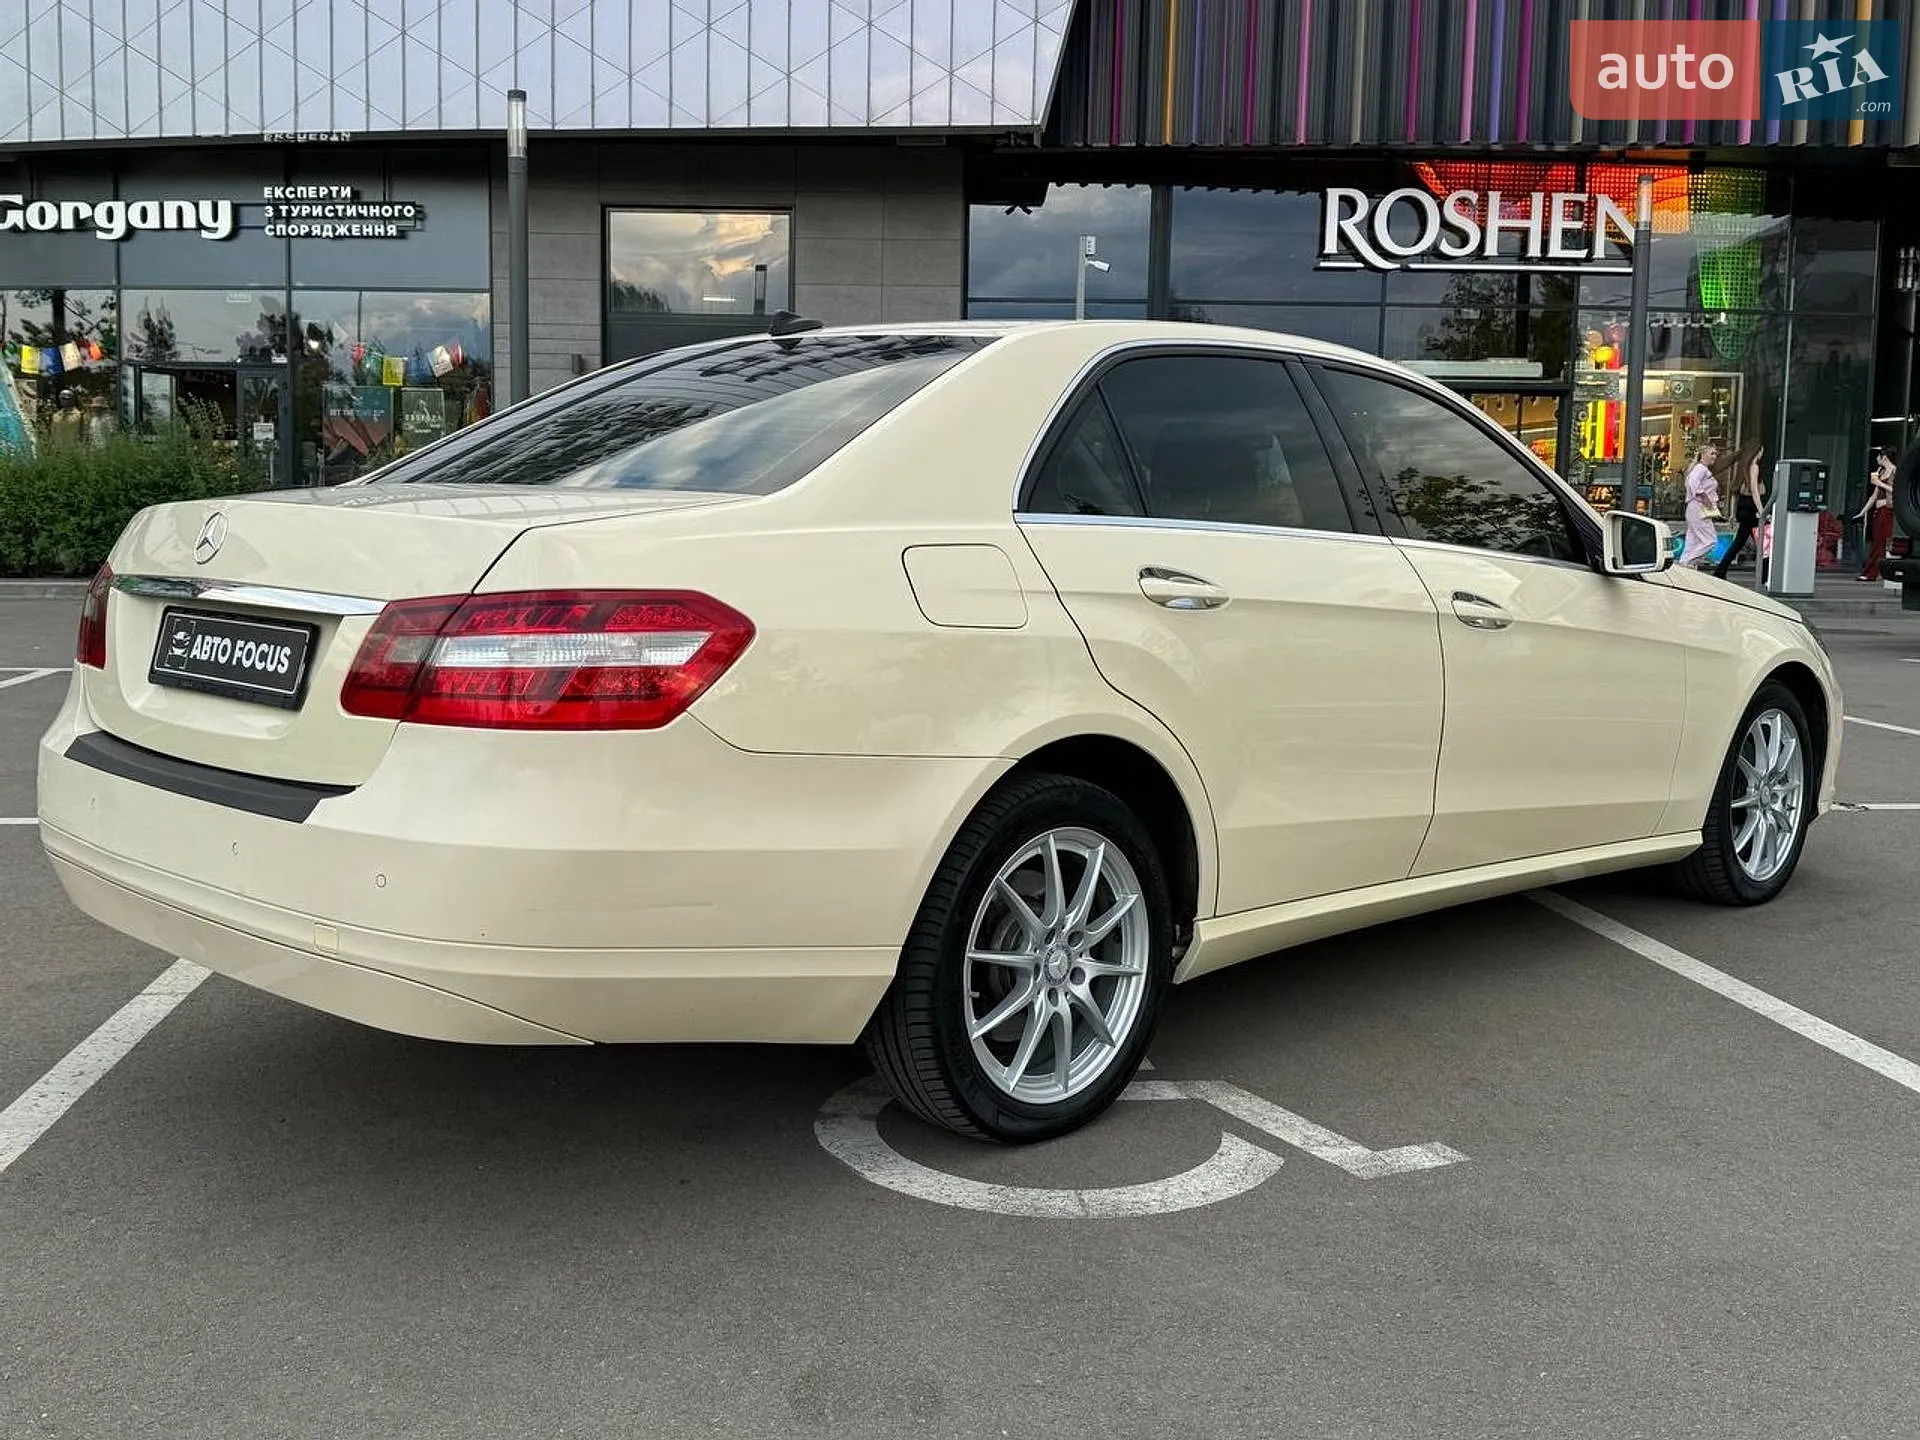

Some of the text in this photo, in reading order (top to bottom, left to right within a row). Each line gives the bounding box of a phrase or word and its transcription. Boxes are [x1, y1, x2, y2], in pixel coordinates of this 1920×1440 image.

[264, 186, 351, 199] ЕКСПЕРТИ
[279, 205, 415, 217] ТУРИСТИЧНОГО
[264, 224, 397, 238] СПОРЯДЖЕННЯ
[1323, 187, 1635, 270] ROSHEN
[232, 640, 291, 674] FOCUS
